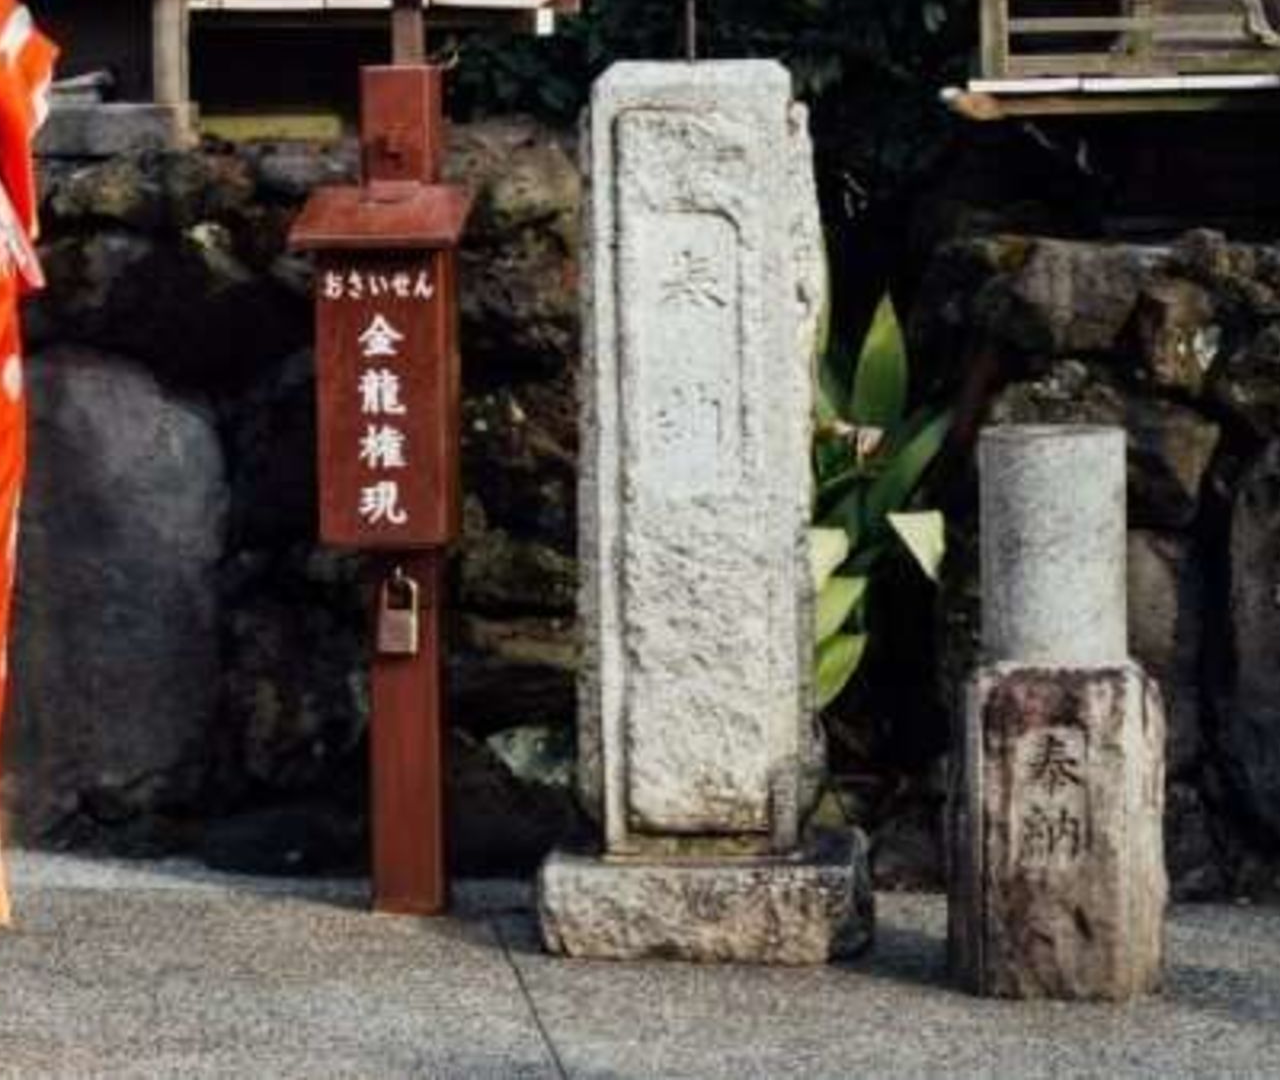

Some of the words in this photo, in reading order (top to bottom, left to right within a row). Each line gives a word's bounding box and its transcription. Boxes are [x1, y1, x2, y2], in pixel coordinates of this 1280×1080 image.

[324, 270, 434, 299] おさいせん
[357, 313, 409, 525] 金龍権現
